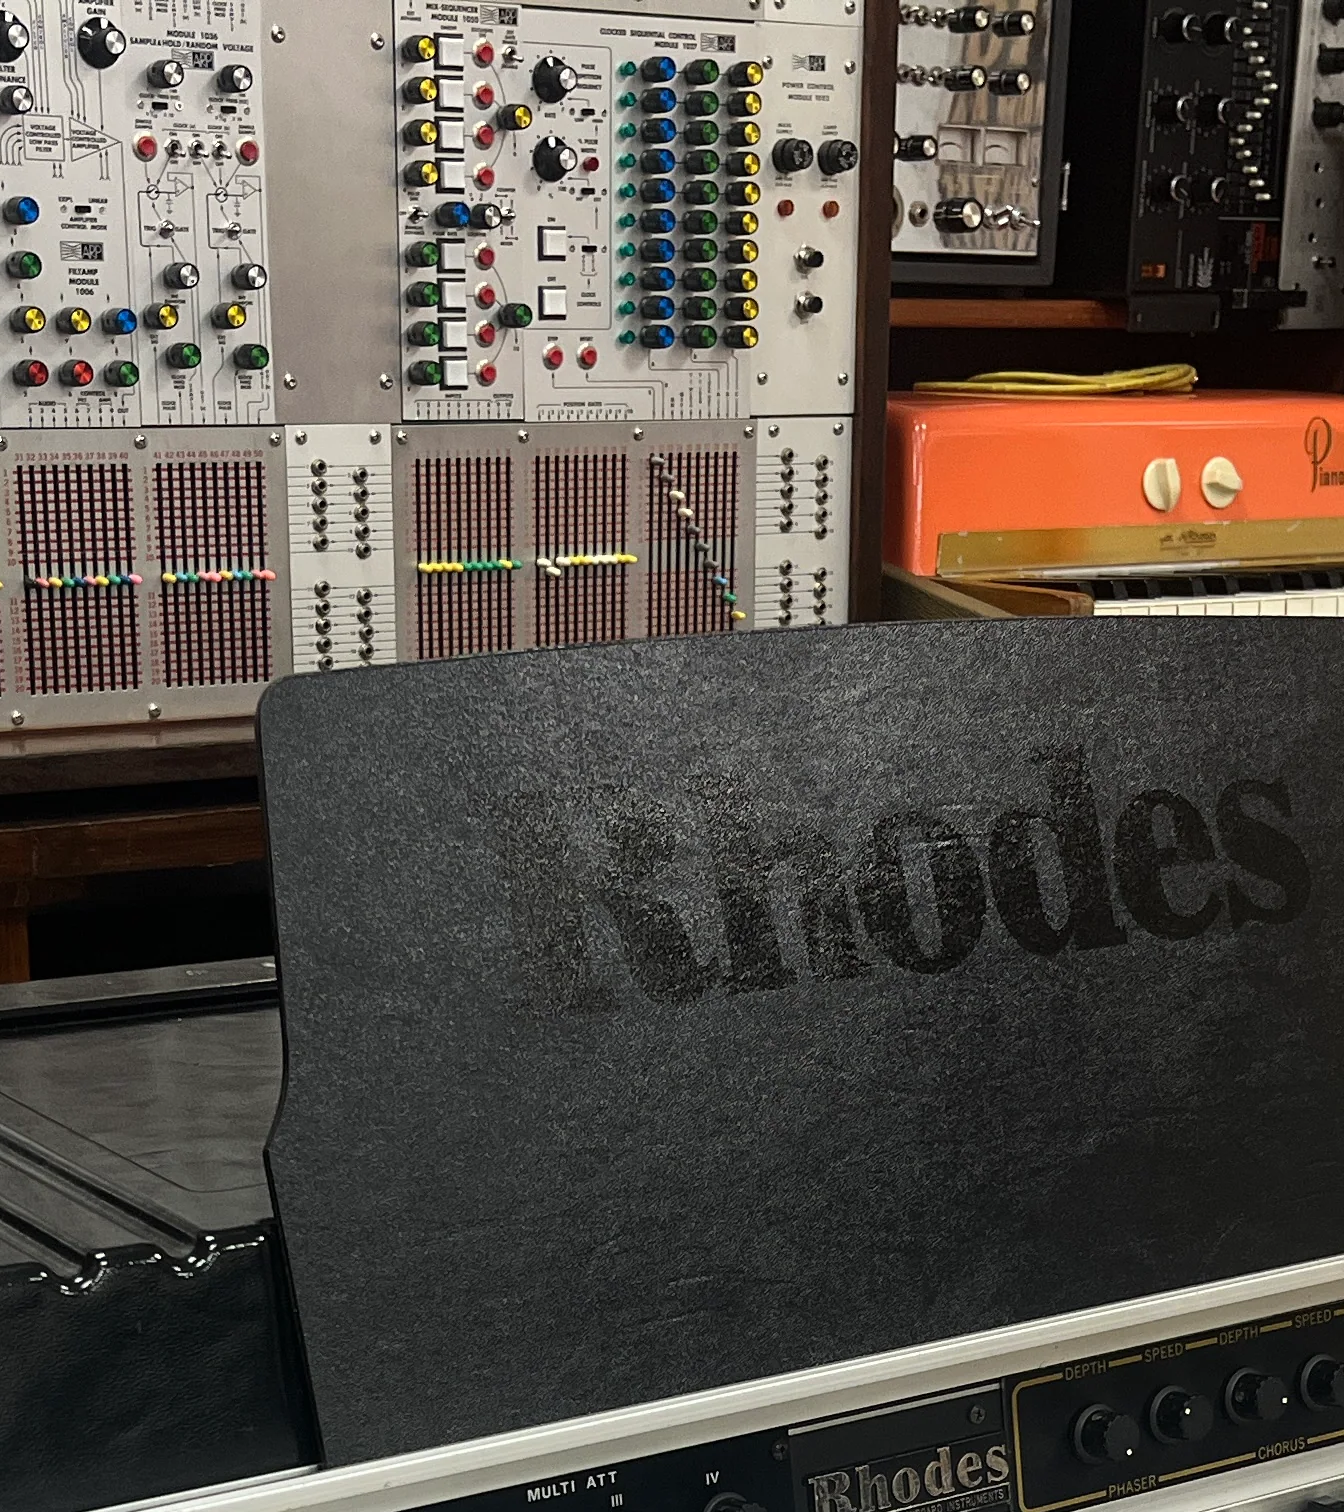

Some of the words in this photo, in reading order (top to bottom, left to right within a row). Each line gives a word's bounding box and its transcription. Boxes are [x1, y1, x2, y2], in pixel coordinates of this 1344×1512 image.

[87, 8, 106, 16] GAIN
[167, 30, 195, 39] MODULE
[223, 44, 253, 52] VOLTAGE
[69, 278, 99, 286] MODULE
[1304, 417, 1344, 493] Piano
[488, 747, 1314, 1006] Rhodes
[1294, 1309, 1332, 1330] SPEED
[1219, 1325, 1258, 1347] DEPTH
[1144, 1342, 1184, 1363] SPEED
[1064, 1361, 1107, 1382] DEPTH
[1258, 1437, 1306, 1460] CHORUS
[527, 1480, 575, 1502] MULTI
[587, 1471, 617, 1489] ATT
[705, 1471, 720, 1485] IV
[1108, 1474, 1157, 1498] PHASER
[610, 1494, 623, 1507] III
[946, 1488, 1005, 1512] INSTRUMENTS
